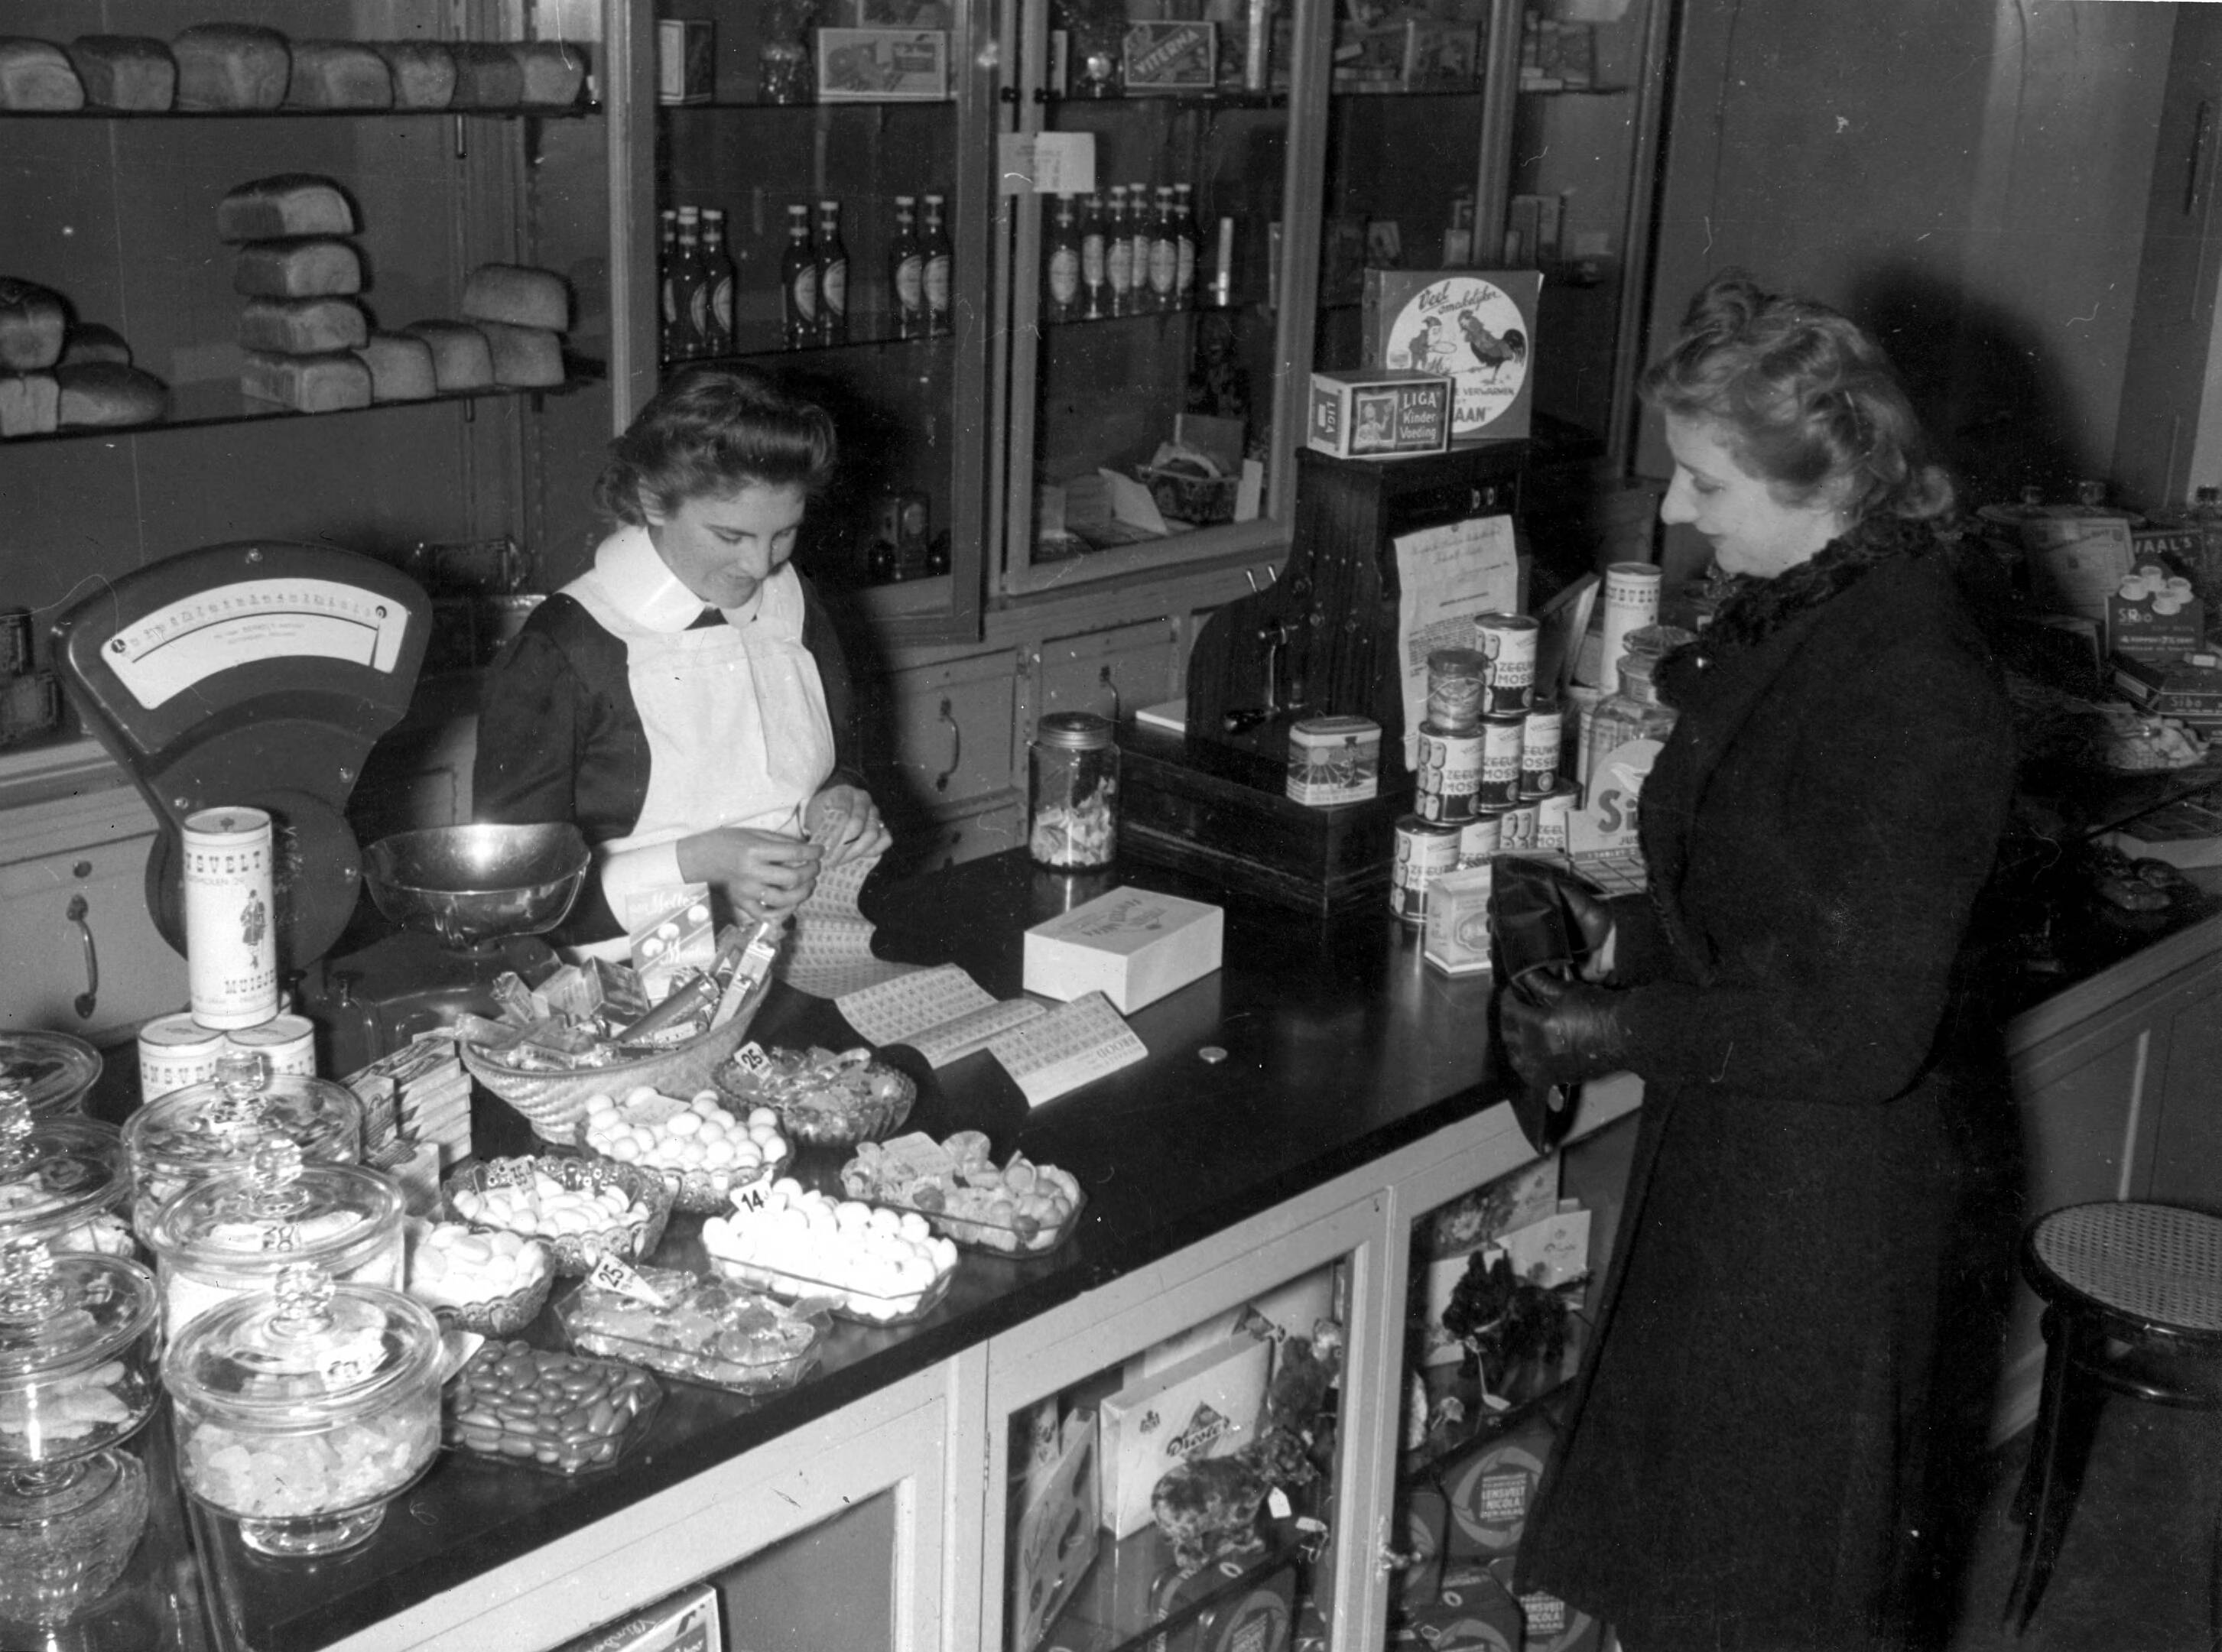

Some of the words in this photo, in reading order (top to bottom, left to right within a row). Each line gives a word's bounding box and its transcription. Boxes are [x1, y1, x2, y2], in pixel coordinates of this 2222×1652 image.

[1134, 30, 1199, 73] VITERMA
[1418, 281, 1450, 311] Veel
[1463, 387, 1515, 396] VERWARMEN
[1325, 401, 1336, 433] LIGA
[1403, 408, 1437, 424] Kinder
[1399, 426, 1437, 440] Voeding
[1096, 1034, 1137, 1059] BROOD
[741, 1048, 763, 1070] 25
[742, 1189, 764, 1212] 14
[598, 1264, 624, 1287] 25
[1482, 1486, 1525, 1500] LENSVELT
[1486, 1498, 1520, 1510] NICOLA
